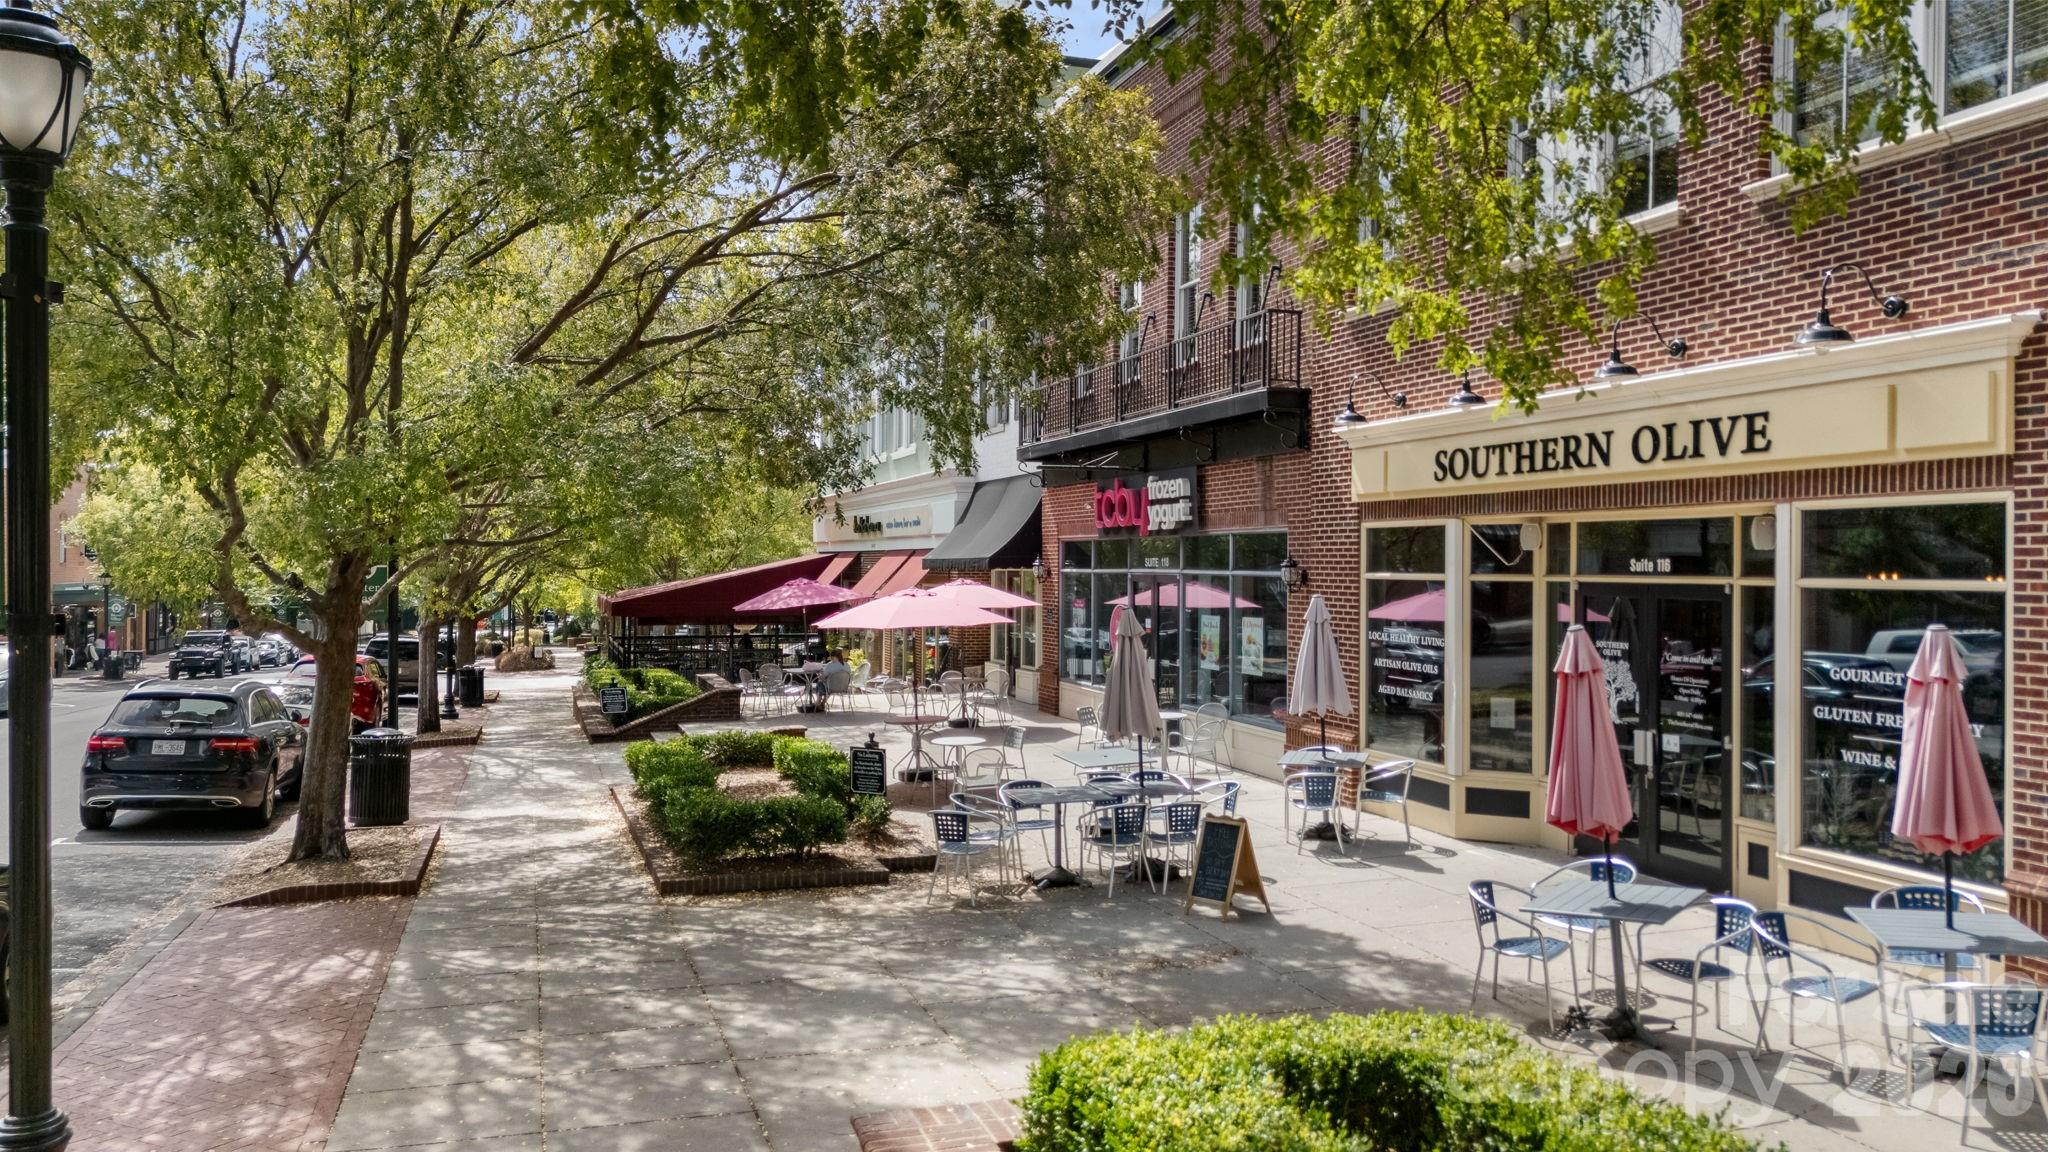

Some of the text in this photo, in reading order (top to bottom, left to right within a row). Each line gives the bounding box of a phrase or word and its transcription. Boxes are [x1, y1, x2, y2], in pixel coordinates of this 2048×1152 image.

[1434, 411, 1772, 482] SOUTHERN OLIVE
[1147, 475, 1190, 500] frozen
[1095, 478, 1149, 536] tcby
[1147, 498, 1192, 530] yogurt
[1144, 558, 1159, 567] SUITE
[1630, 558, 1671, 572] Suite 116
[1368, 631, 1445, 647] LOCAL HEALTHY LIVING
[1596, 641, 1629, 650] SOUTHERN
[1602, 649, 1622, 657] OLIVE
[1374, 658, 1439, 674] ARTISAN OLIVE OILS
[1829, 667, 1904, 686] GOURMET
[1378, 685, 1433, 701] AGED BALSAMICS
[1813, 706, 1904, 728] GLUTEN FRE
[1840, 749, 1897, 770] WINE &
